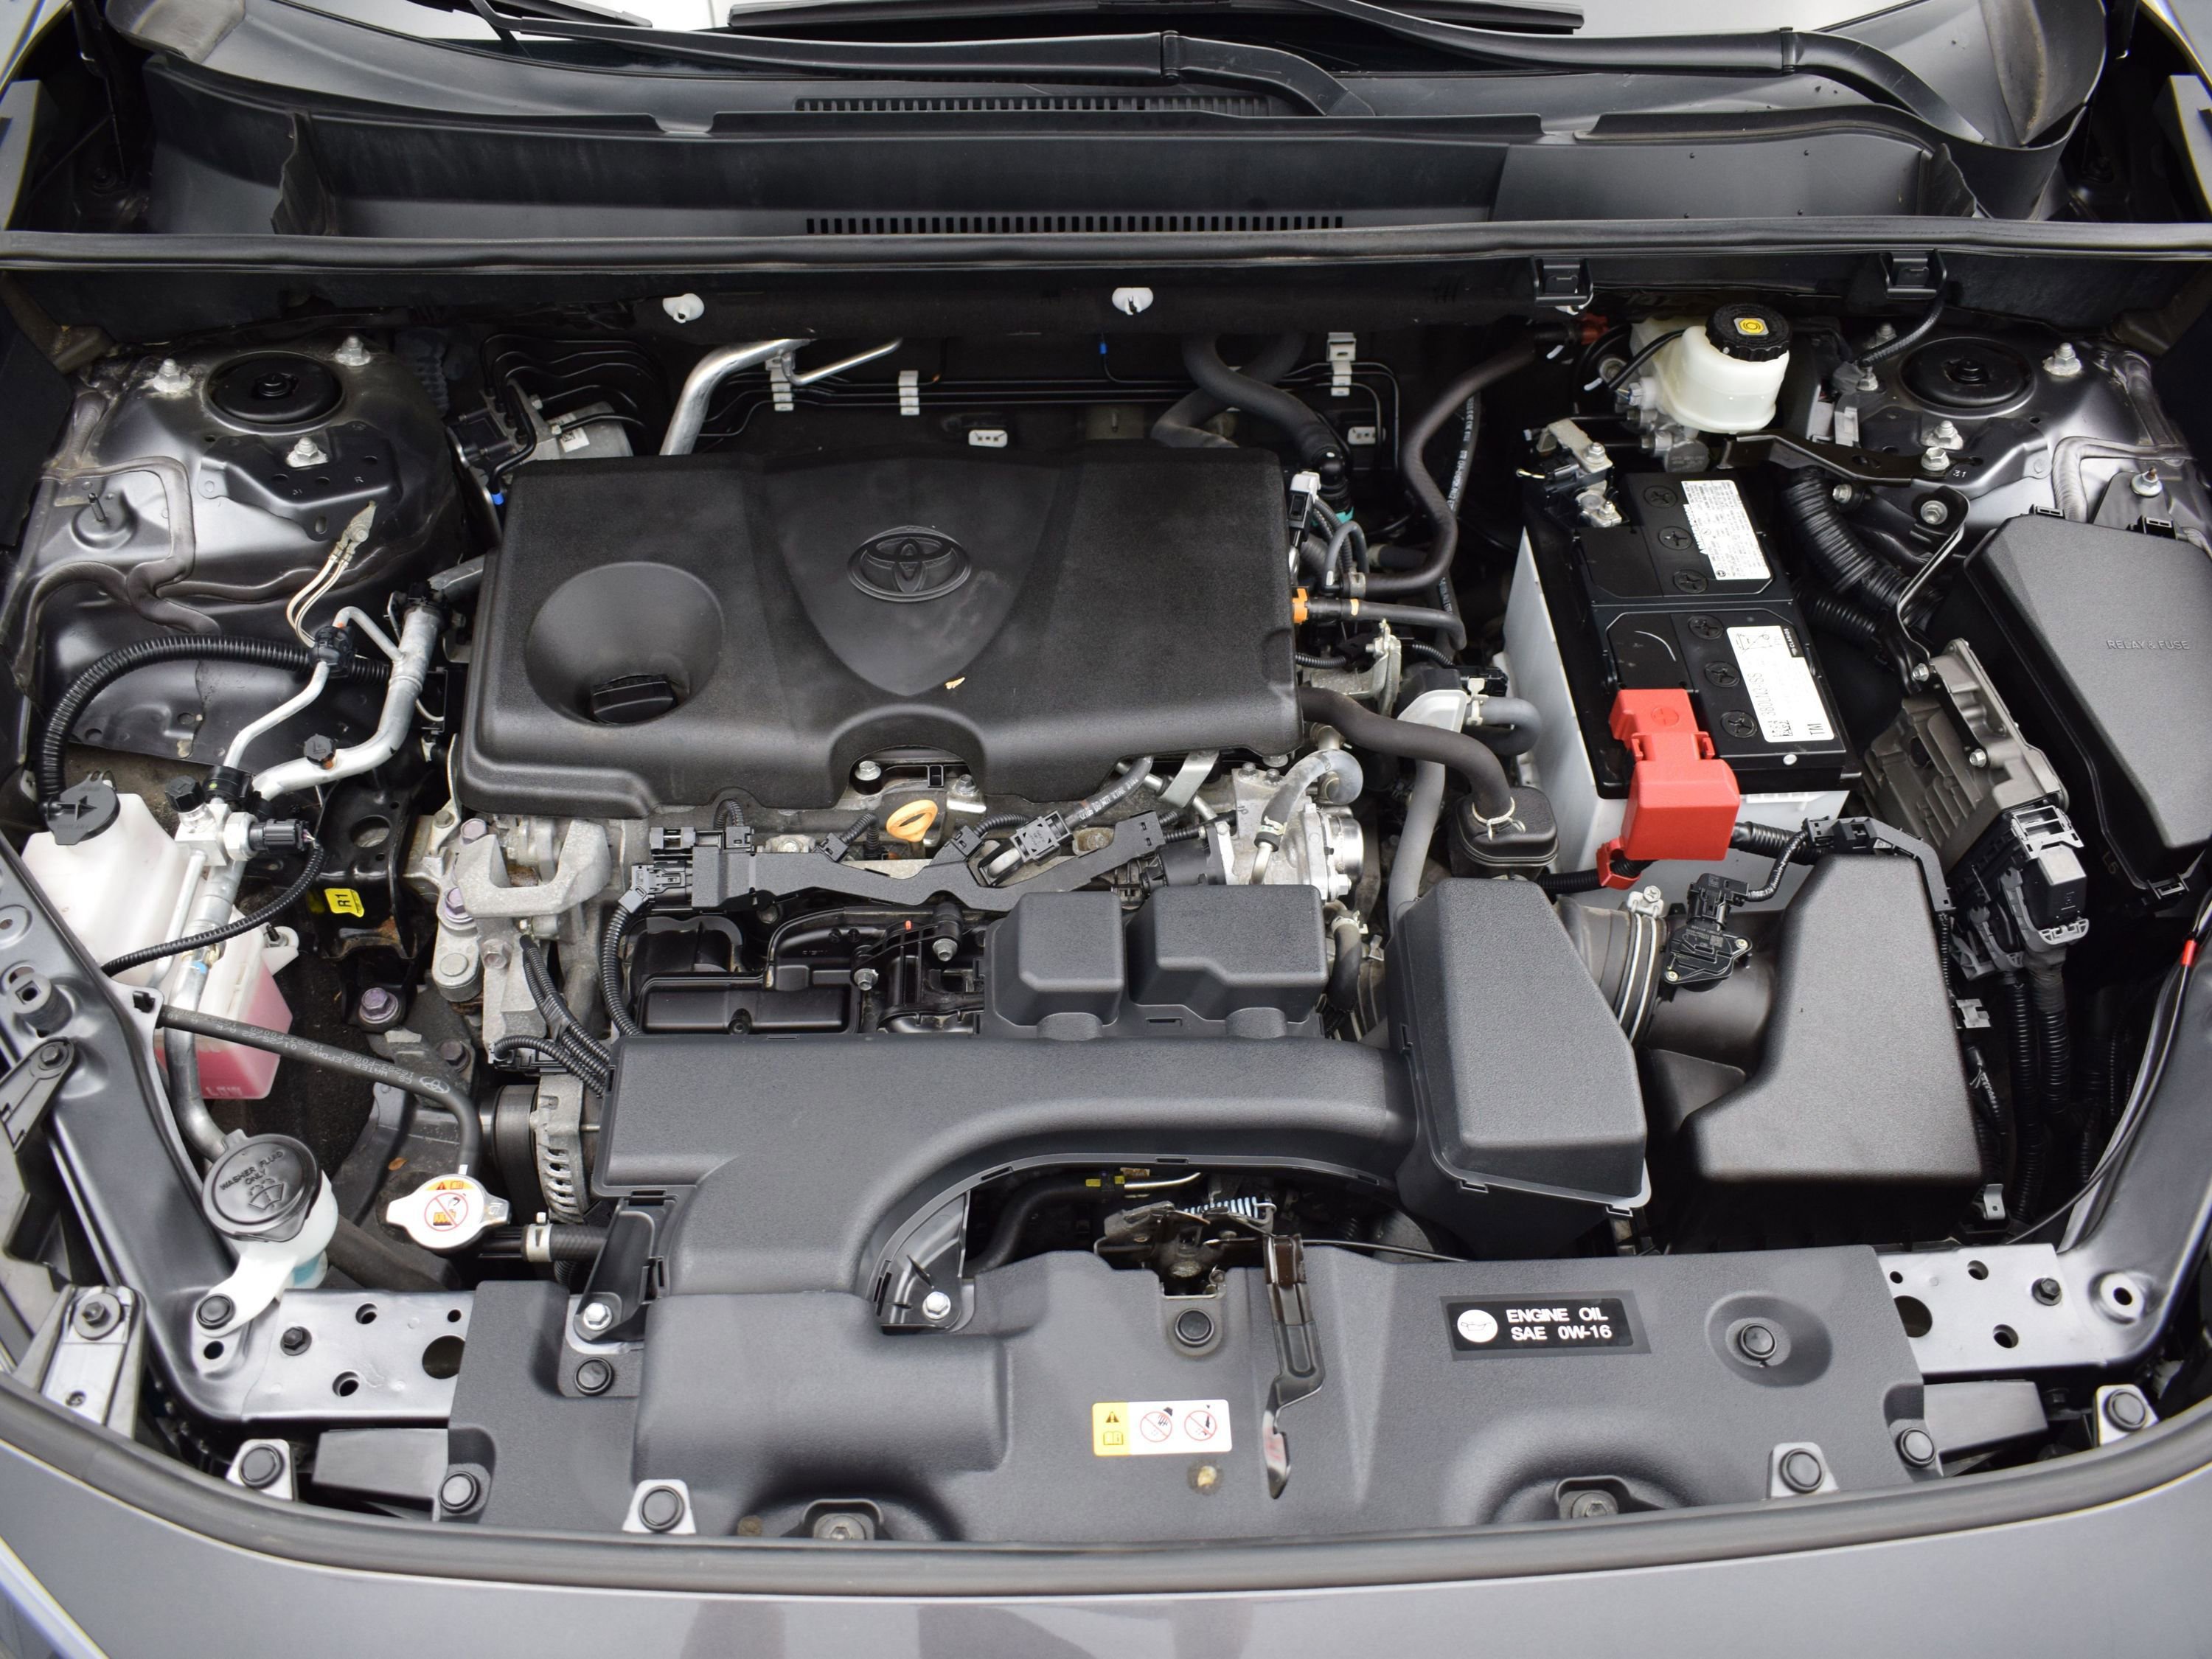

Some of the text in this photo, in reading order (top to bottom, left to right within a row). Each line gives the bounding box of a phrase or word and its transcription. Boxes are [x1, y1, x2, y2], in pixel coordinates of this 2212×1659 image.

[2107, 640, 2191, 650] RELAY & FUSE
[1806, 723, 1825, 736] TM
[335, 894, 352, 908] R1
[241, 1031, 298, 1050] 01/25/22
[250, 1026, 324, 1051] 16283-F0060
[342, 1051, 415, 1077] 16283-F0060
[353, 1061, 388, 1077] WATER
[205, 1086, 242, 1096] LOW
[220, 1150, 284, 1190] WASHER FLUID
[245, 1169, 267, 1185] ONLY
[1506, 1307, 1609, 1323] ENGINE OIL
[1510, 1324, 1613, 1341] SAE 0W-16
